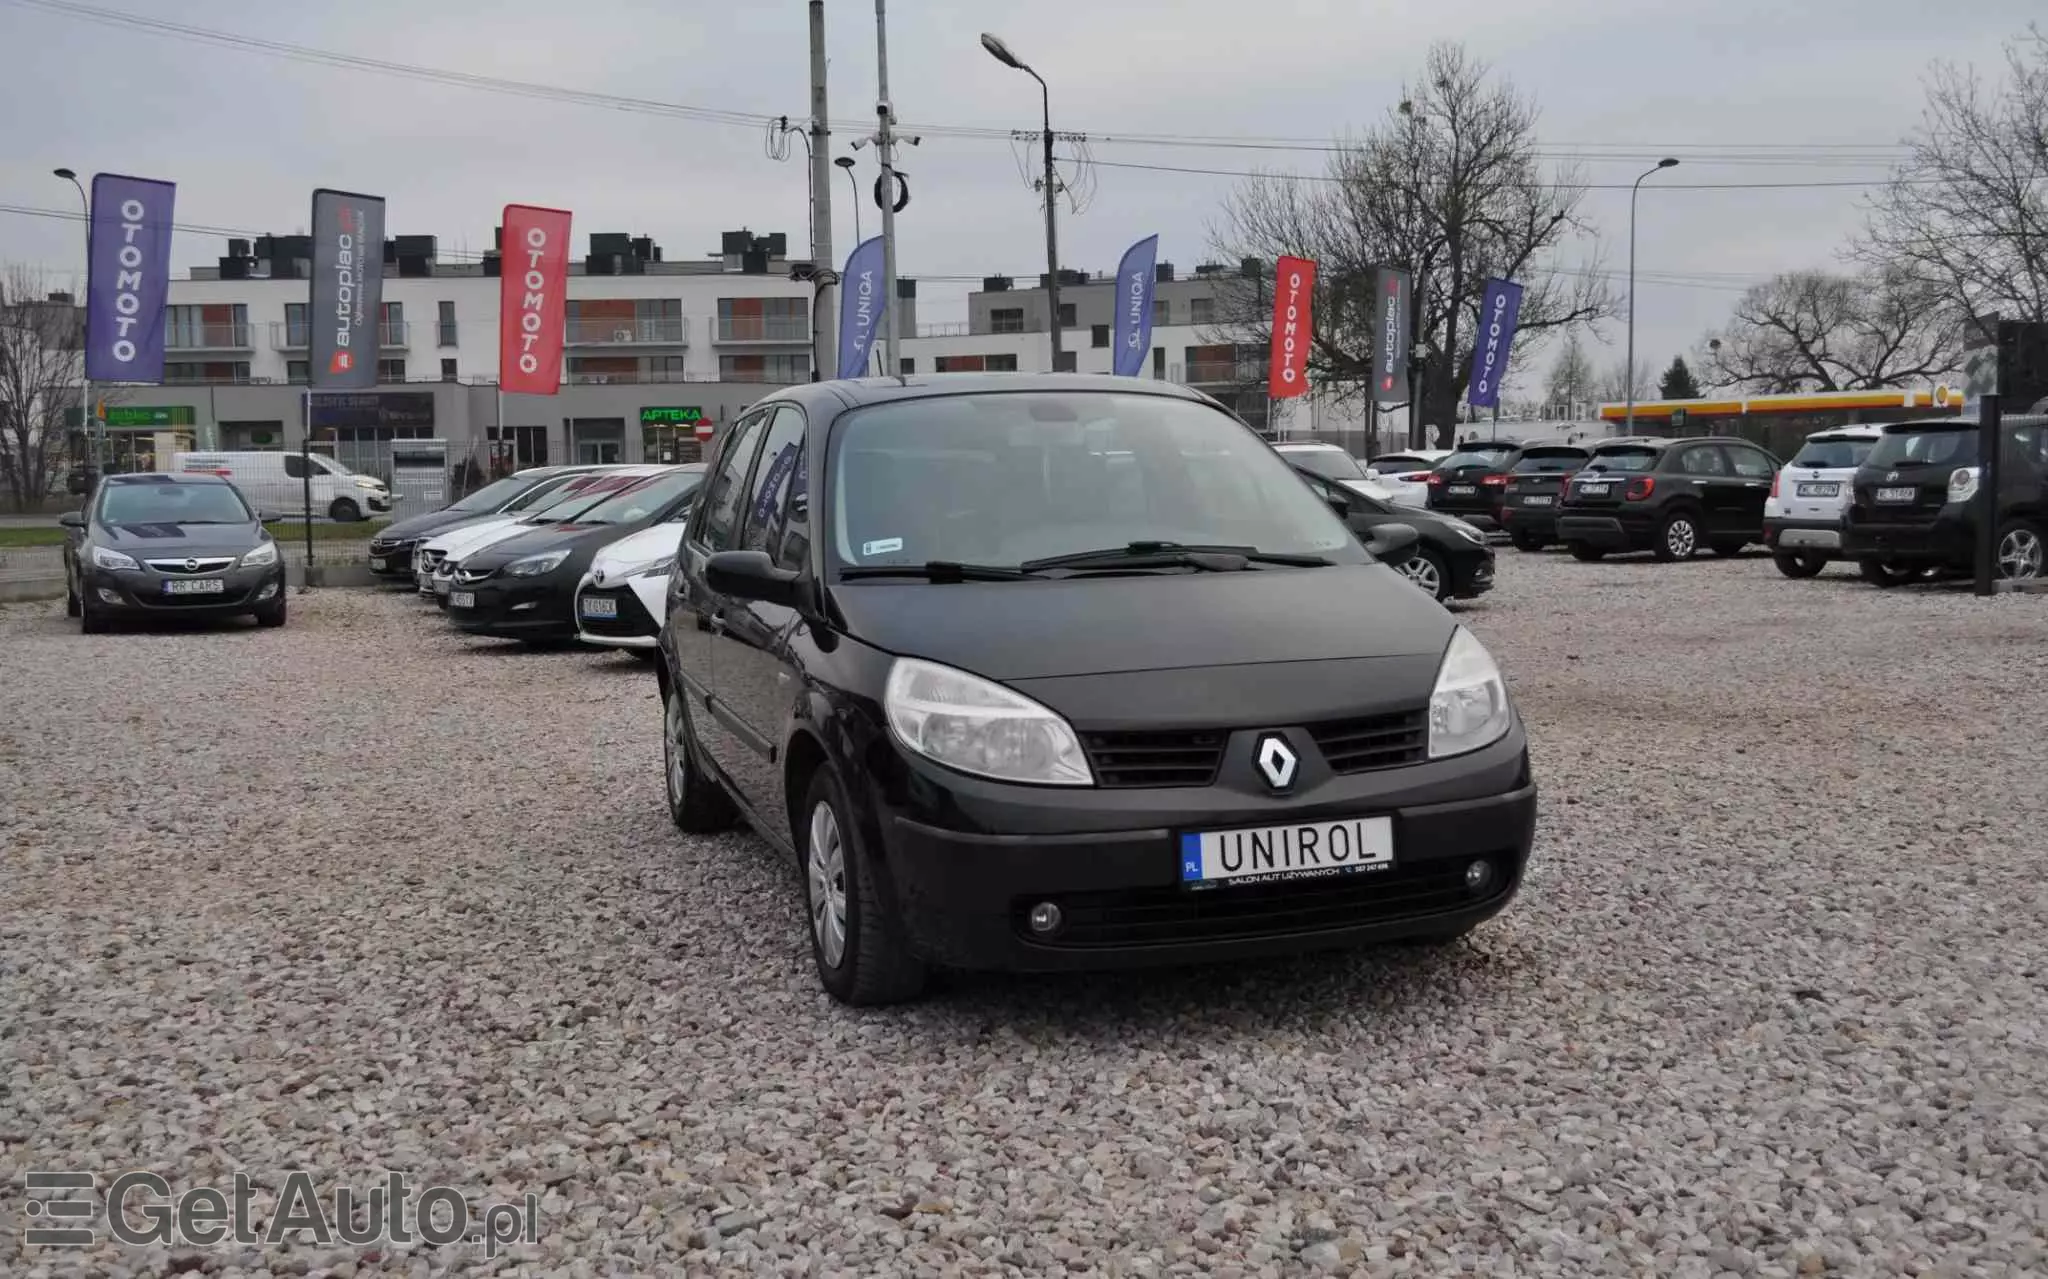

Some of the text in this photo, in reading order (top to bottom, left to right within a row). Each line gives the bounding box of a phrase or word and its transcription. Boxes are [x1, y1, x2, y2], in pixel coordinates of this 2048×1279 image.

[113, 200, 144, 362] OTOMOTO
[519, 228, 546, 374] OTOMOTO
[857, 271, 872, 326] UNIQA
[1130, 271, 1144, 325] UNIQA
[1282, 273, 1301, 383] OTOMOTO
[1479, 294, 1506, 393] OTOMOTO
[642, 409, 701, 420] APTEKA
[1185, 862, 1199, 873] PL
[1220, 822, 1377, 872] UNIROL
[1228, 875, 1260, 886] SALON
